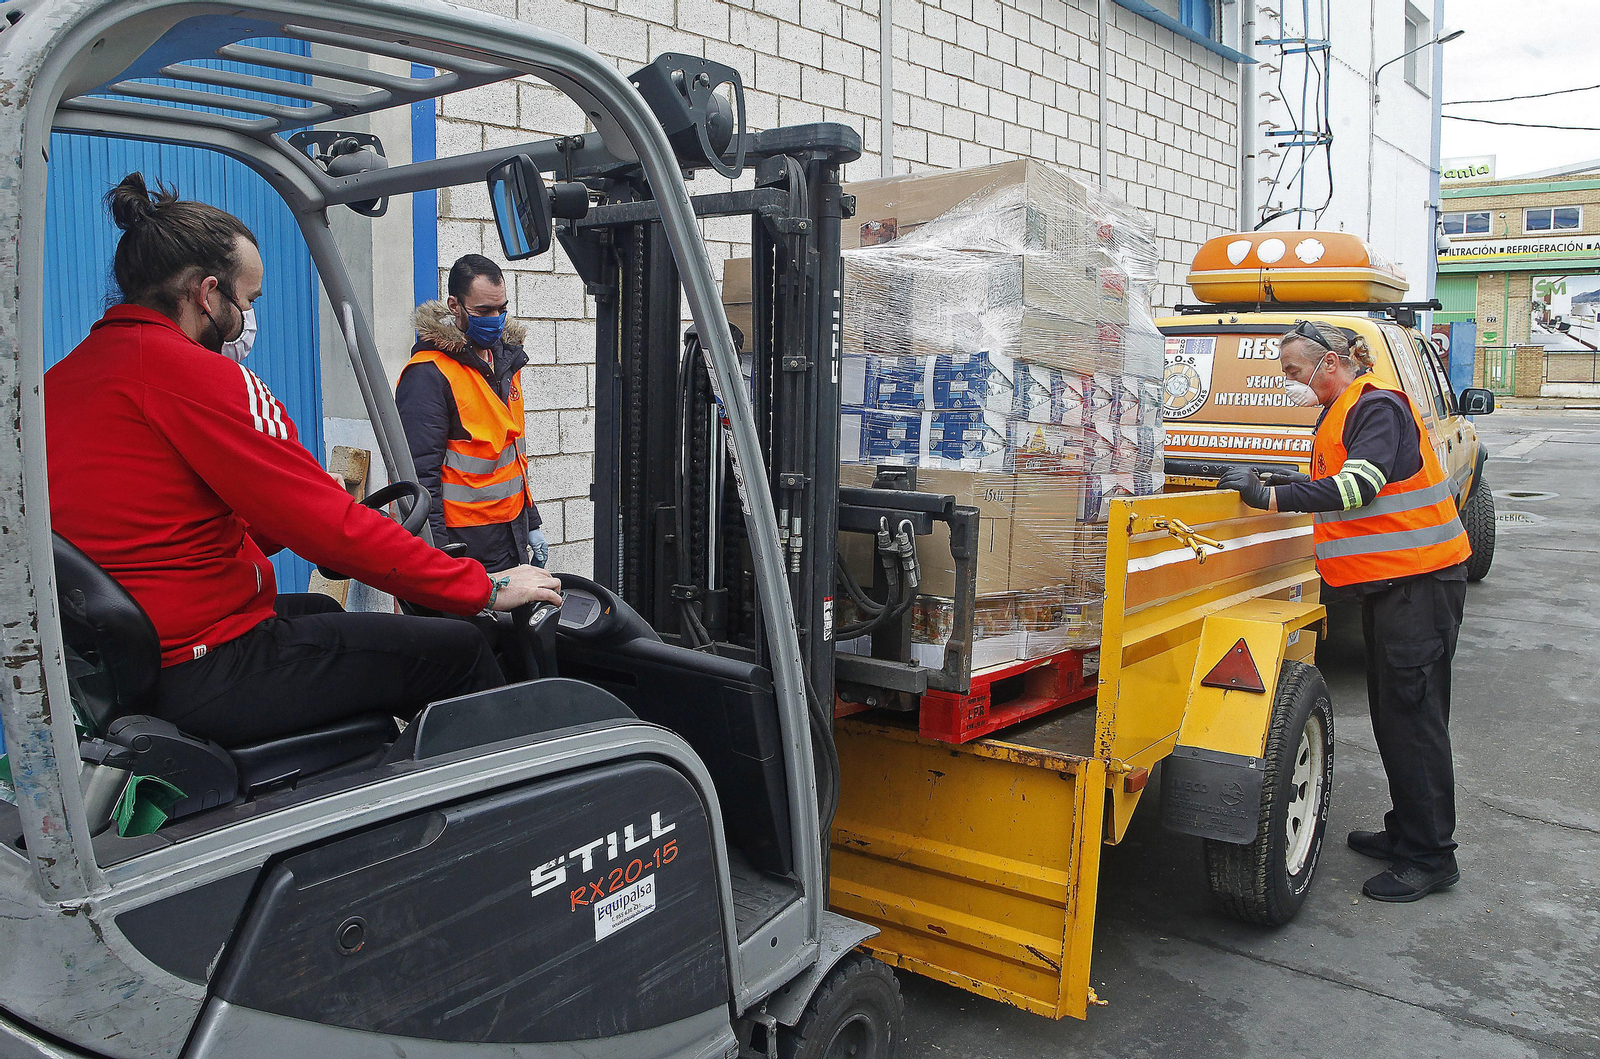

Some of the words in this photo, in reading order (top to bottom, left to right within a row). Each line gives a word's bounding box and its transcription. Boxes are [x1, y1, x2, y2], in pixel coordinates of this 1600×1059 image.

[1506, 241, 1583, 254] REFRIGERACIÓN
[1534, 279, 1566, 297] SM
[968, 705, 984, 719] LPR
[530, 811, 676, 898] STILL
[597, 883, 652, 921] Equipalsa
